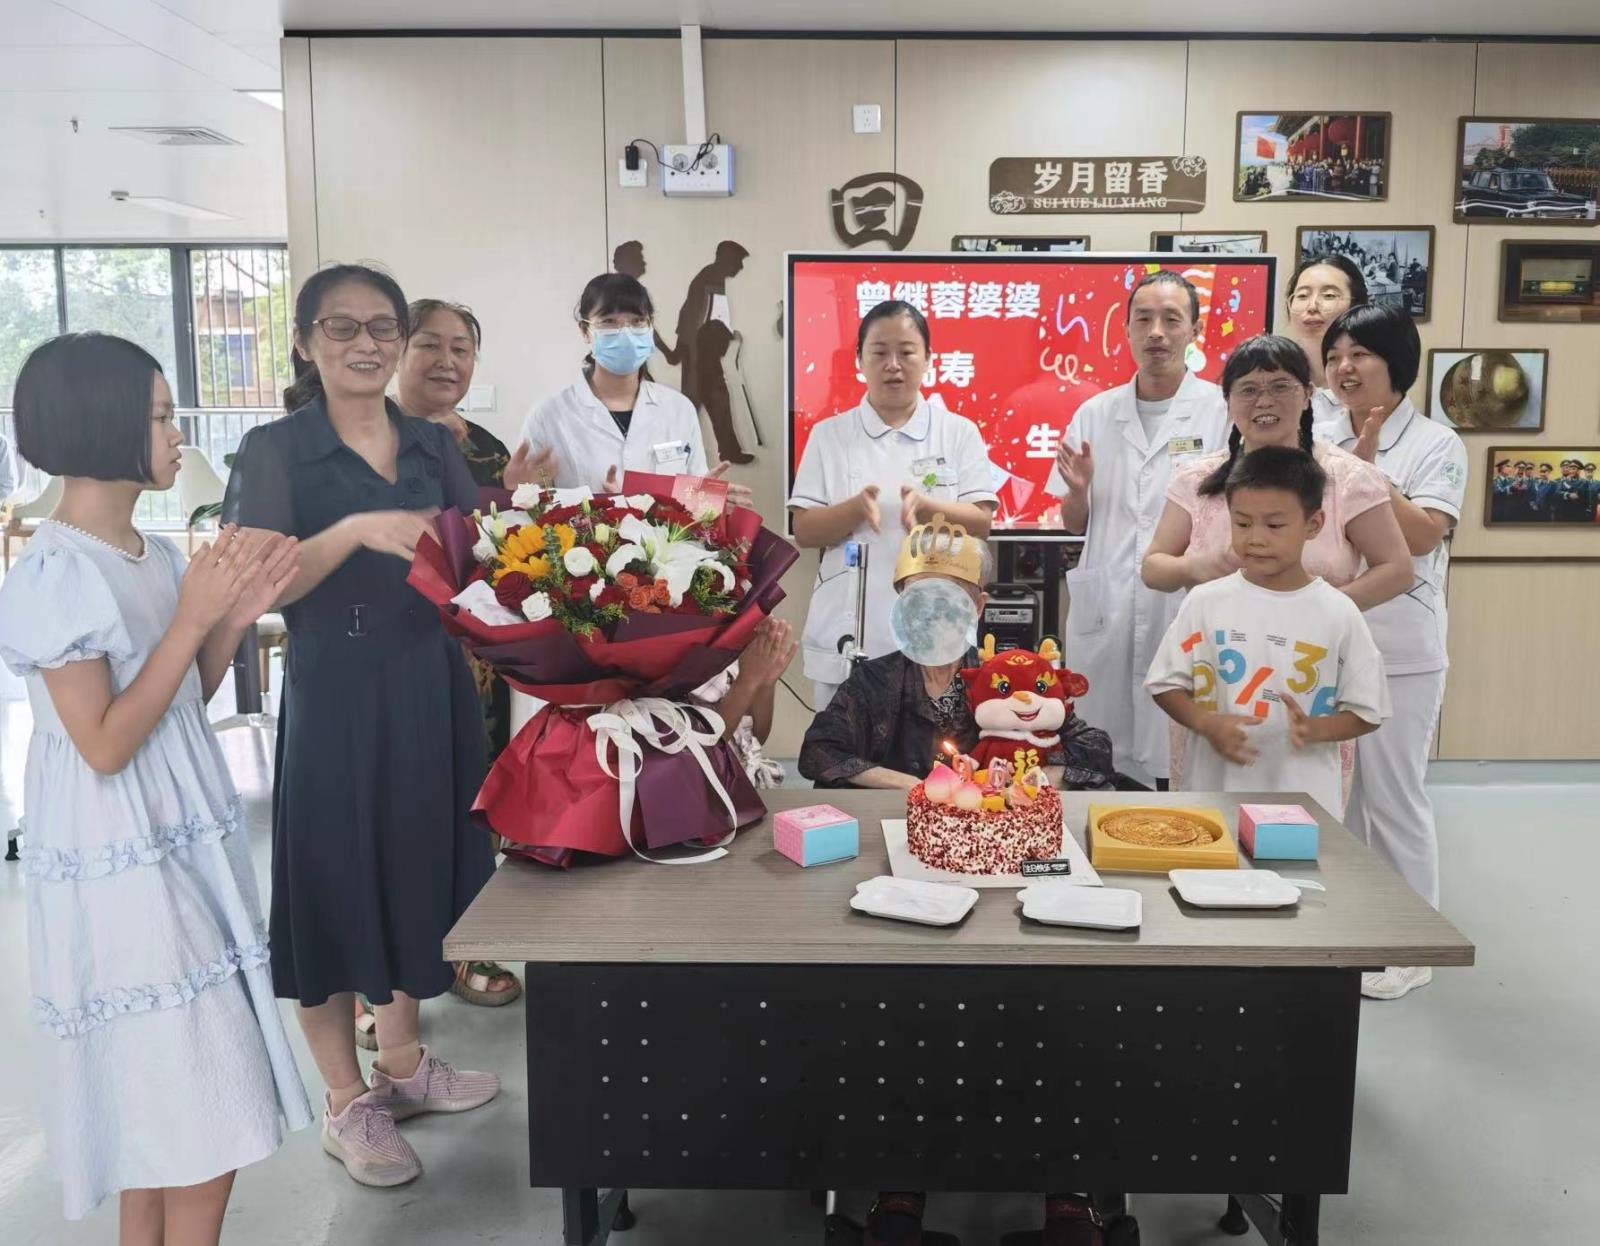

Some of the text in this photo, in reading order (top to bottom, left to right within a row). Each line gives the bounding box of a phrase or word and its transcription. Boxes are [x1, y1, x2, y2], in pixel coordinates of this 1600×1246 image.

[1034, 161, 1168, 194] 岁月留香
[1034, 197, 1057, 208] SUI
[1062, 197, 1089, 208] YUE
[1120, 196, 1168, 208] XIANG
